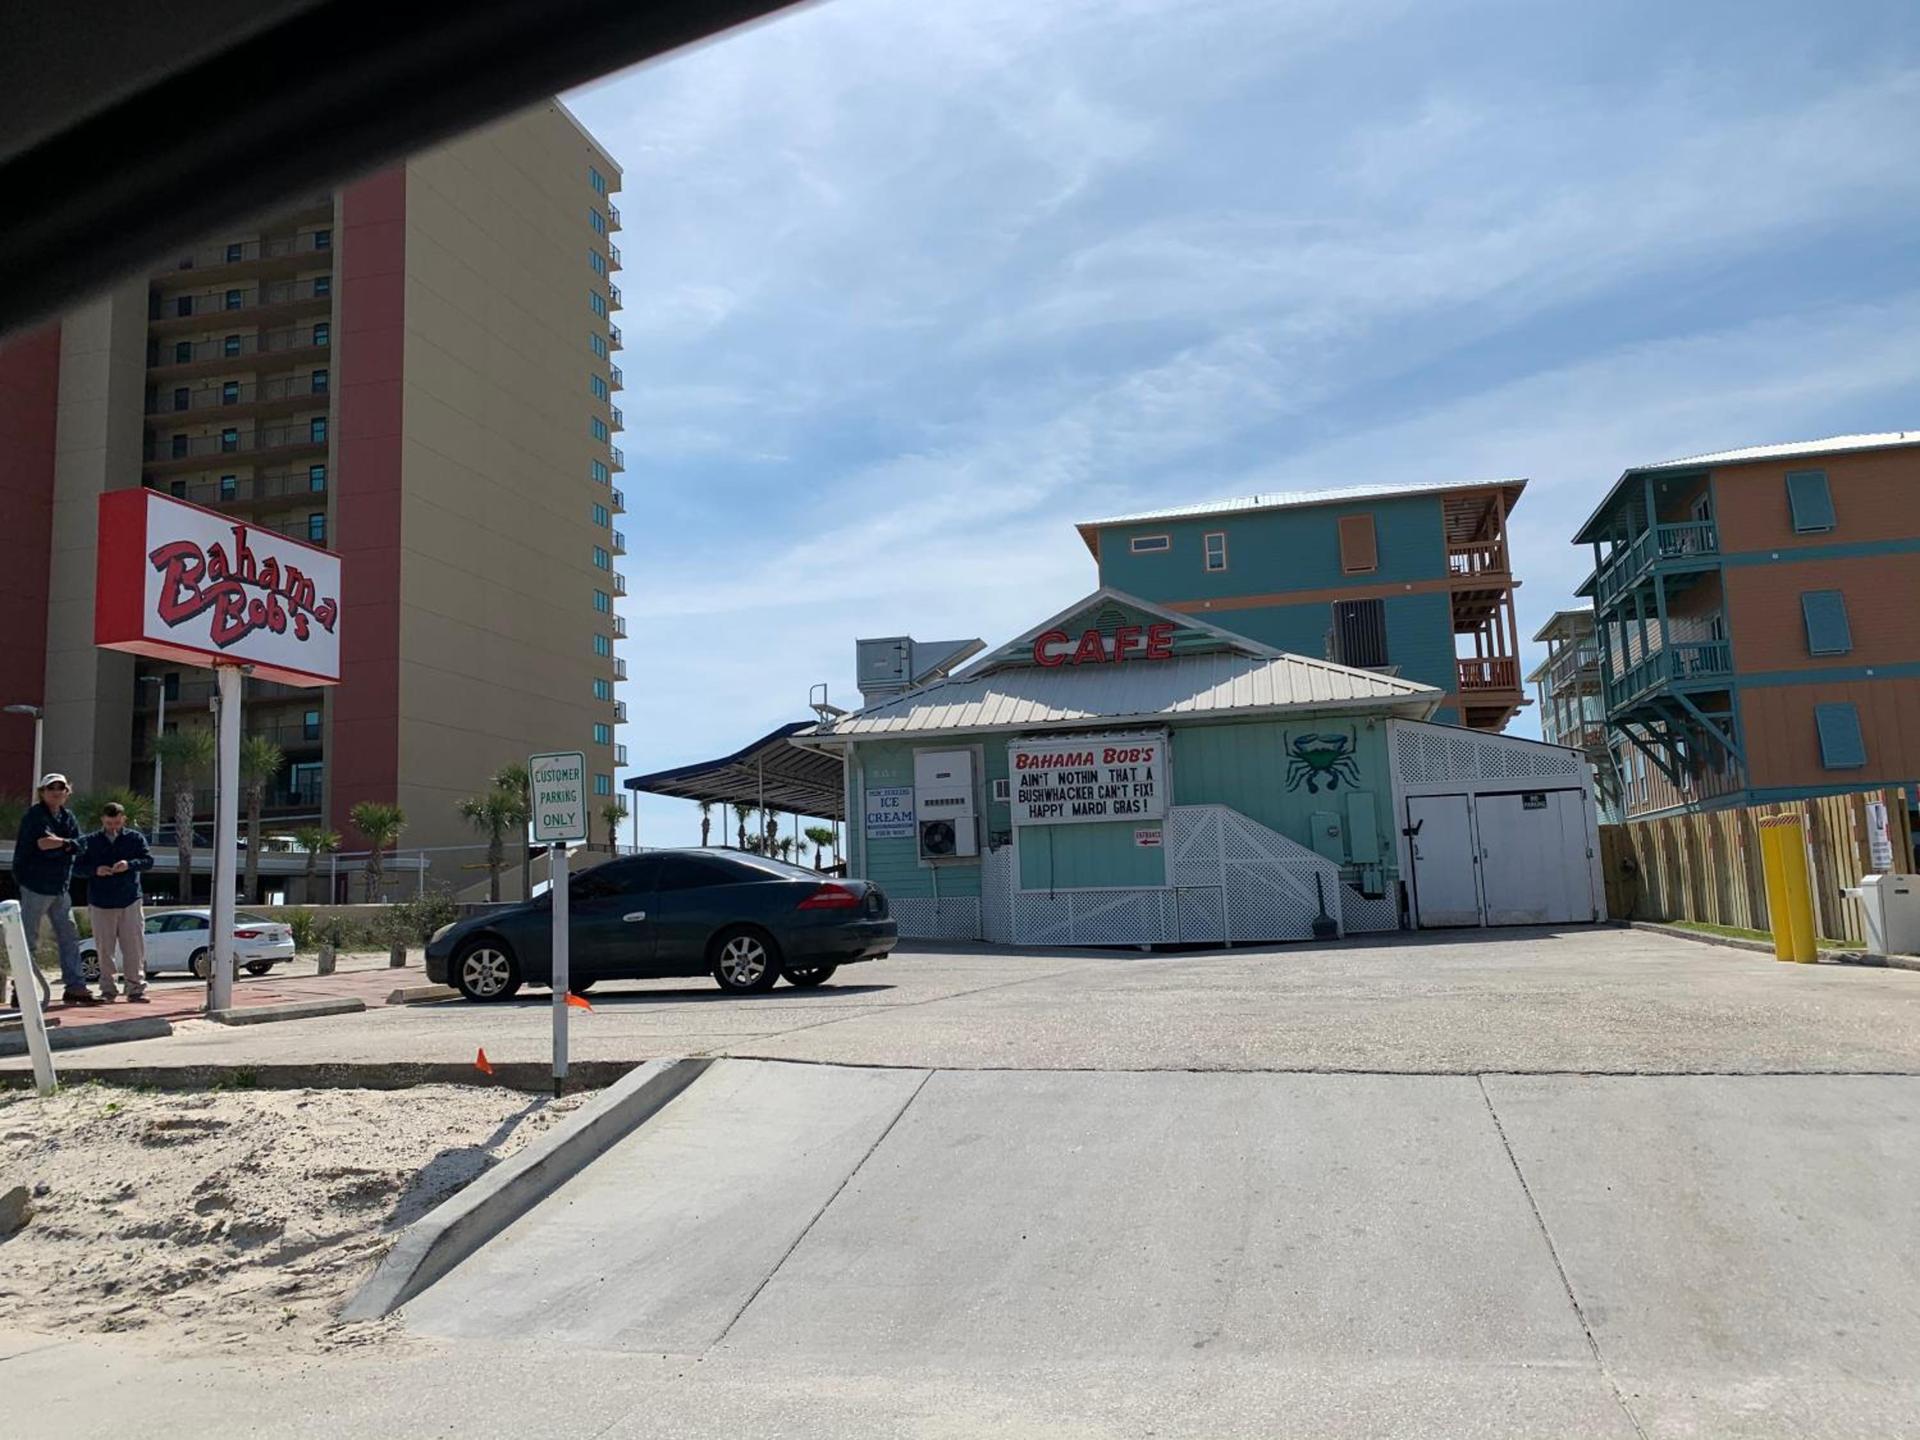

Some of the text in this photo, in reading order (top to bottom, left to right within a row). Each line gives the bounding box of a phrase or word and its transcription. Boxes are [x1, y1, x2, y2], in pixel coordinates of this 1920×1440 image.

[149, 524, 338, 634] Bahama
[1033, 623, 1176, 668] CAFE
[1015, 747, 1154, 770] BAHAMA BOB'S
[535, 768, 580, 783] CUSTOMER
[1020, 767, 1153, 787] AIN'T NOTHIN THAT A
[540, 789, 577, 804] PARKING
[1018, 783, 1154, 803] BUSHWHACKER CAN'T FIX!
[880, 796, 899, 808] ICE
[1029, 803, 1064, 818] HAPPY
[1072, 801, 1107, 816] MARDI
[543, 812, 576, 827] ONLY
[868, 811, 912, 824] CREAM
